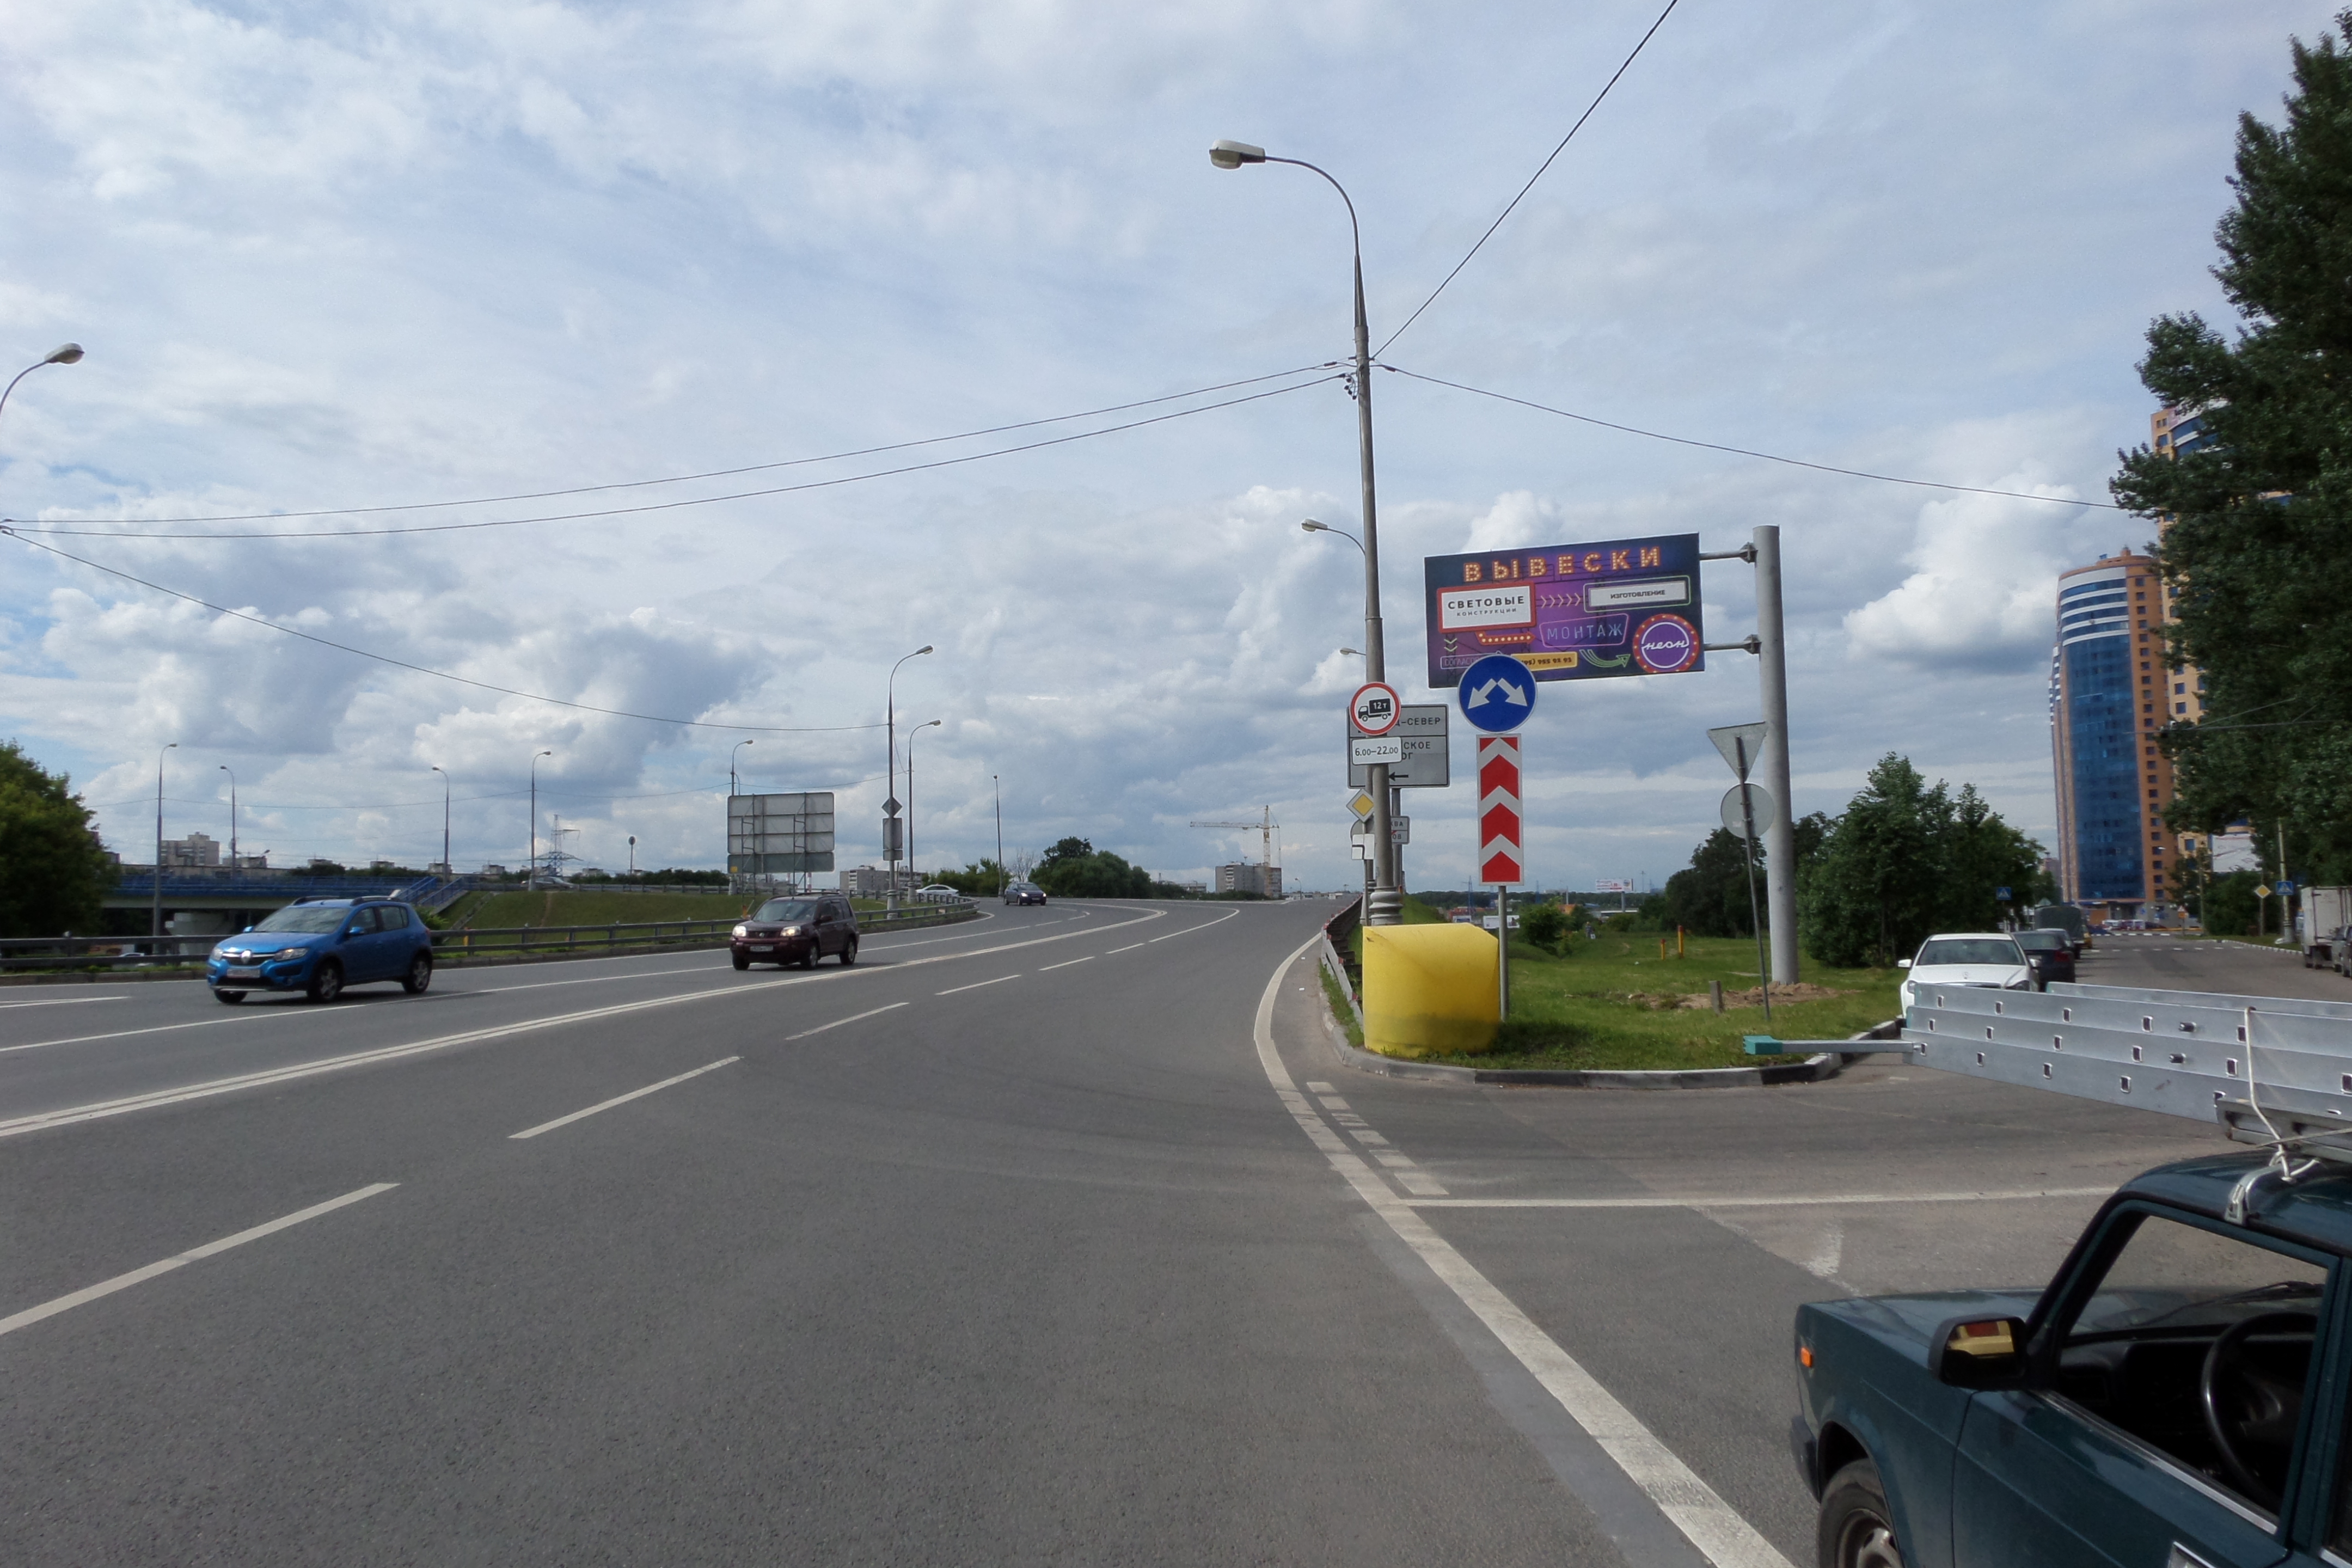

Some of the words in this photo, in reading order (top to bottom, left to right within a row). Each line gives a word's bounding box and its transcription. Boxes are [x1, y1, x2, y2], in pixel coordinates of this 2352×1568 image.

[1463, 546, 1659, 582] ВЫВЕСКИ
[1610, 589, 1666, 599] ИЗГОТОВЛЕНИЕ
[1448, 596, 1524, 609] СВЕТОВЫЕ
[1456, 608, 1517, 616] КОНСТРУКЦИИ
[1547, 623, 1622, 640] МОНТАЖ
[1643, 640, 1688, 650] неон
[1355, 746, 1399, 756] 6.00-22.00
[1404, 742, 1431, 750] СКОЕ
